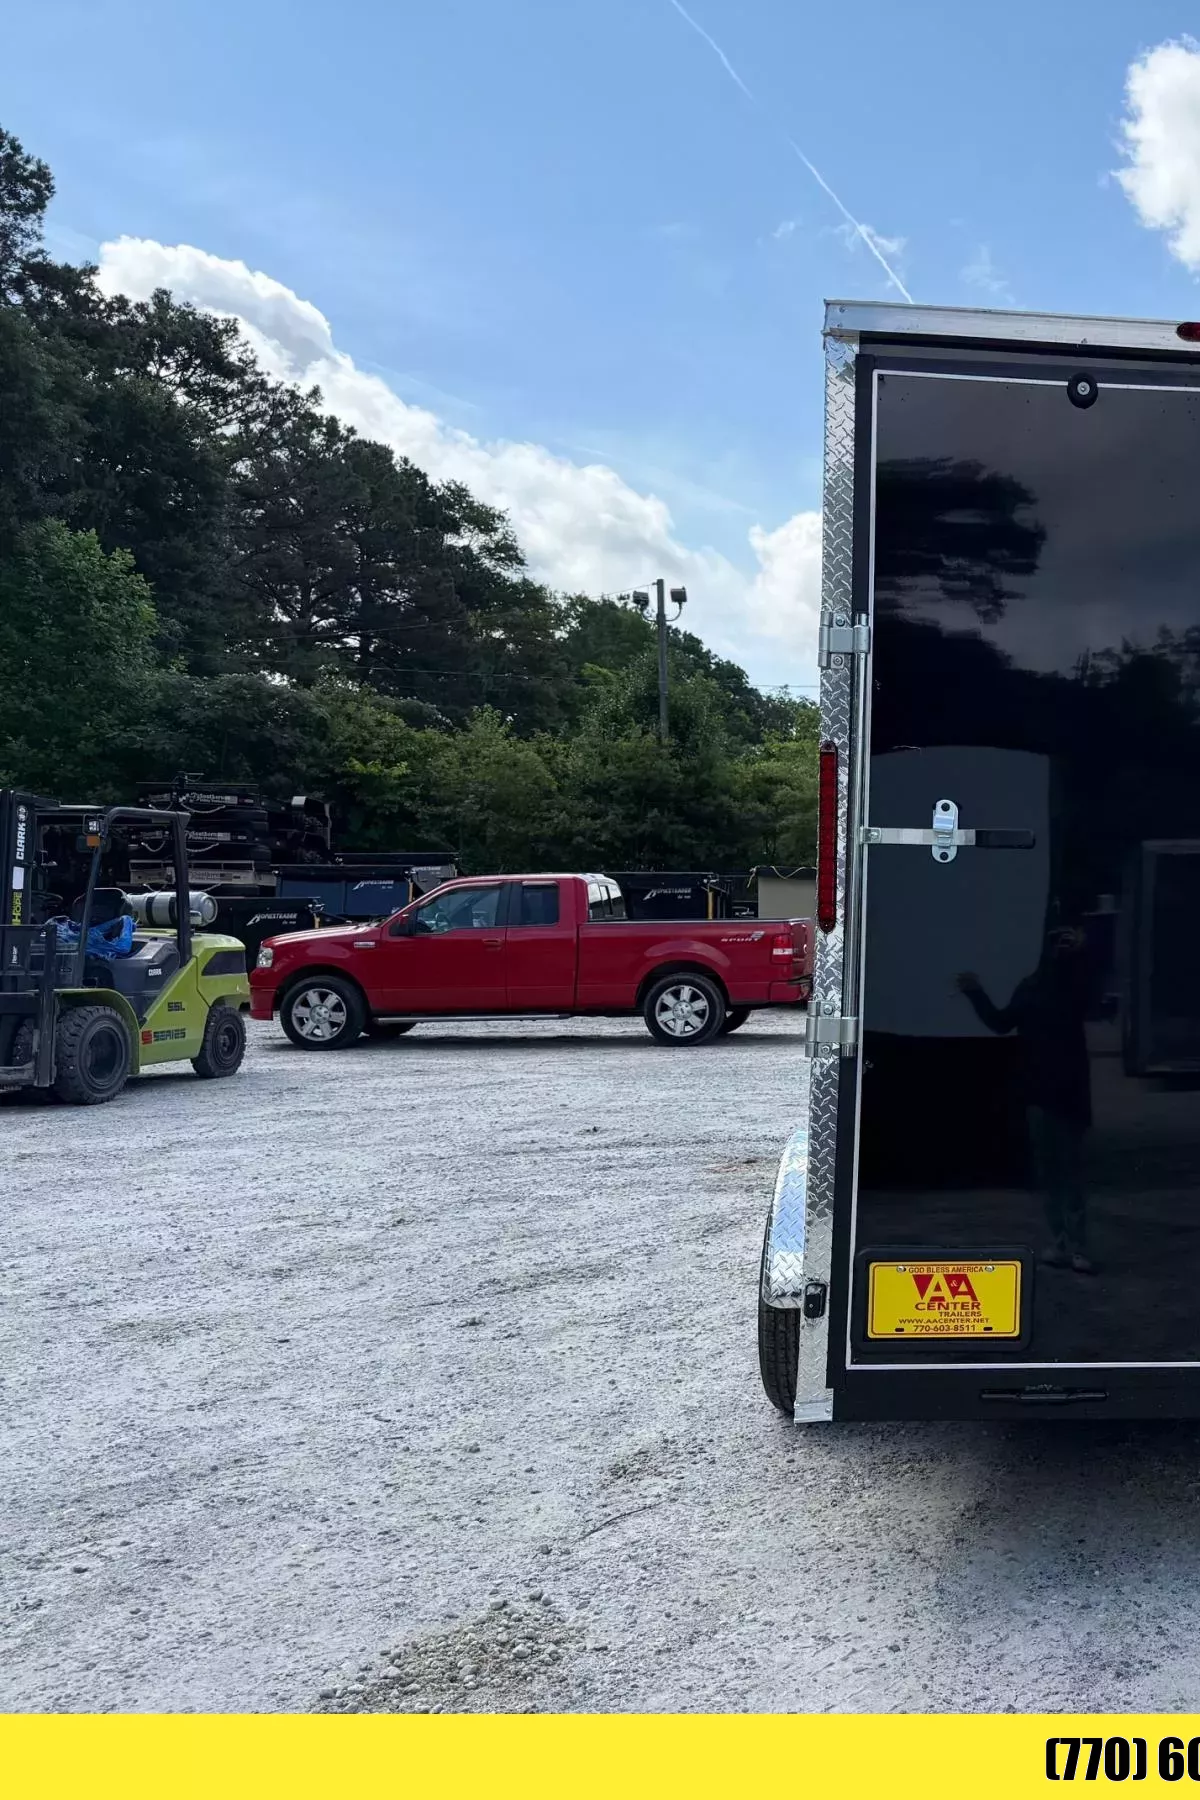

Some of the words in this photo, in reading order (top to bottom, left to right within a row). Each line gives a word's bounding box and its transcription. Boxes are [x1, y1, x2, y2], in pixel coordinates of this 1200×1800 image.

[16, 821, 26, 860] CLARK
[915, 1302, 981, 1310] CENTER
[914, 1324, 976, 1332] 770-603-8511
